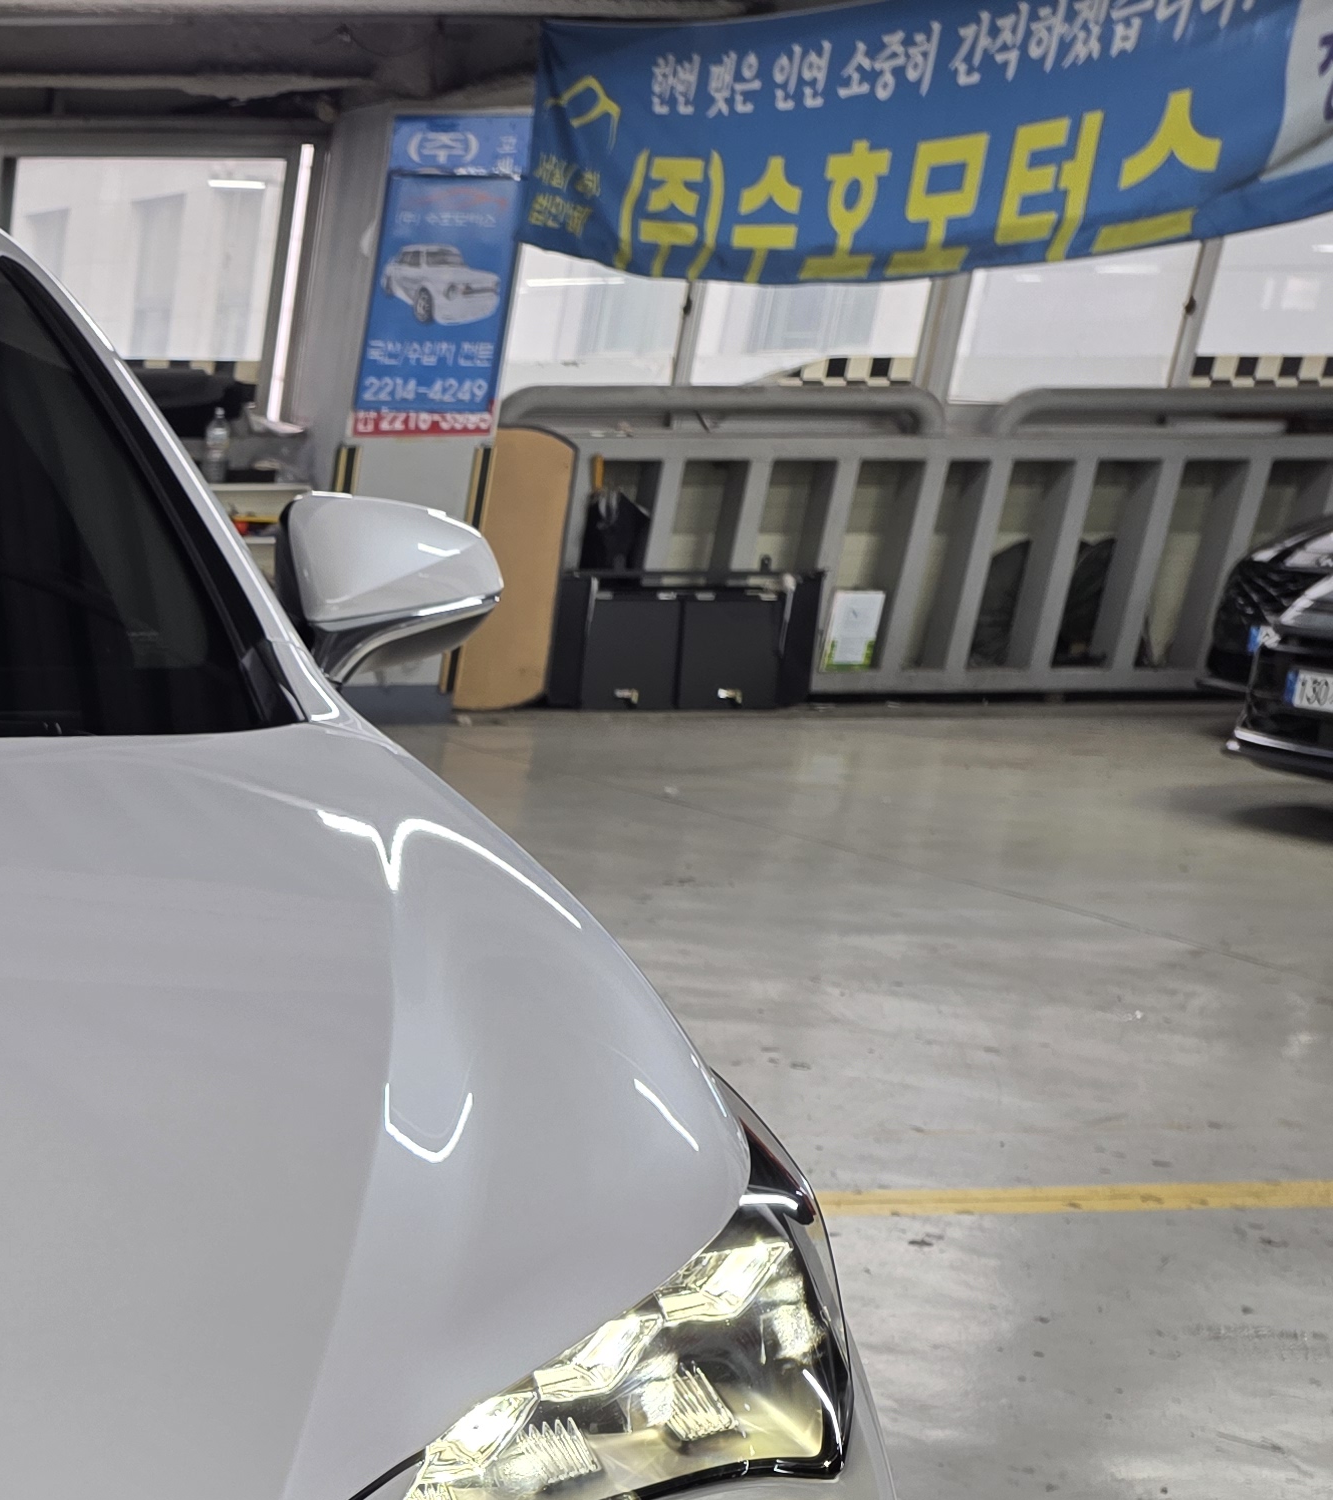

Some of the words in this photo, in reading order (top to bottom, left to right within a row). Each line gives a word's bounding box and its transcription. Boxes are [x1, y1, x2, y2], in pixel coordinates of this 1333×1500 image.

[651, 51, 701, 116] 한번
[706, 50, 763, 119] 맺은
[772, 39, 832, 111] 인연
[836, 20, 942, 101] 소중히
[406, 130, 480, 165] (주)
[613, 88, 1223, 284] (주)수호모터스
[362, 376, 489, 403] 2214-4249
